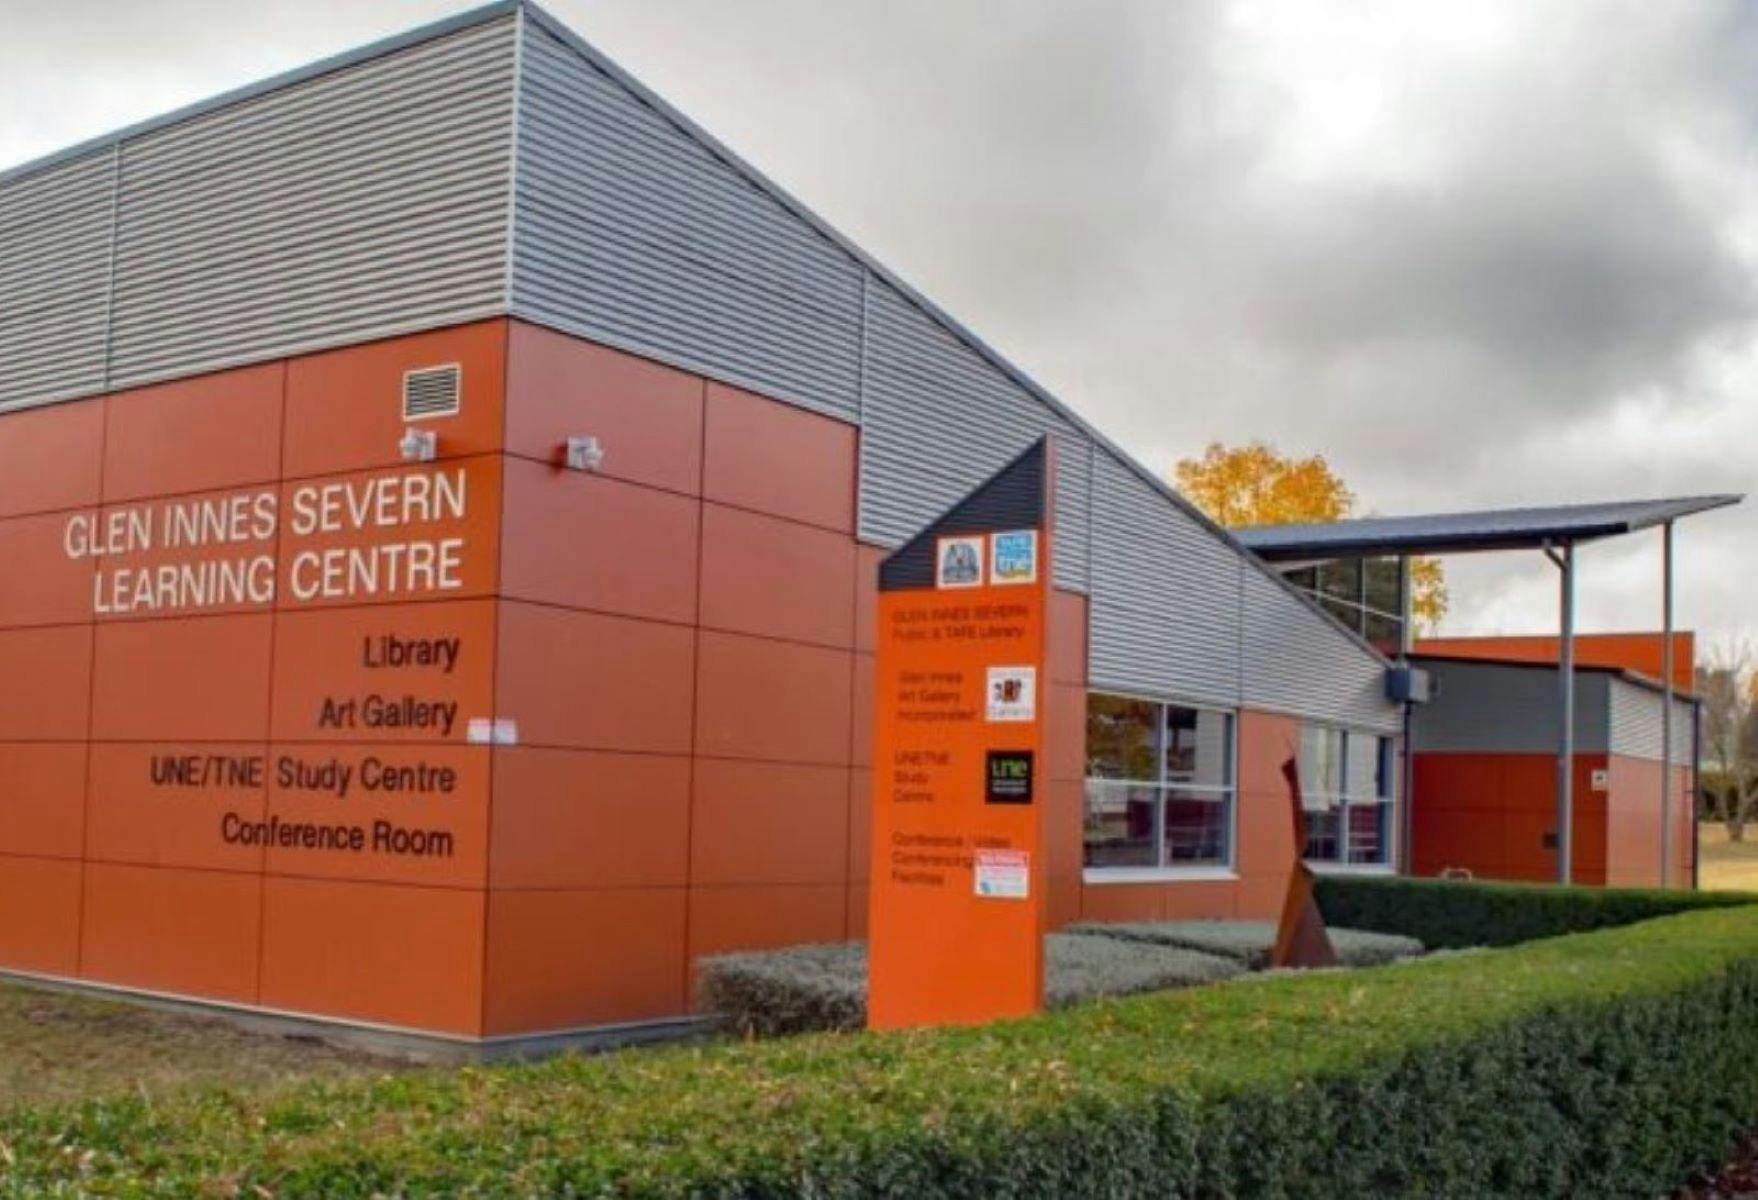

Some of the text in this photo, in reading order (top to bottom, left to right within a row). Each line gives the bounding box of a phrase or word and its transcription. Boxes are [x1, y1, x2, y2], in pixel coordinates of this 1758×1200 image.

[64, 468, 467, 559] GLEN INNES SEVERN
[93, 537, 464, 614] LEARNING CENTRE
[363, 635, 459, 673] Library
[319, 696, 458, 735] Art Gallery
[151, 756, 457, 797] UNE/TNE Study Centre
[222, 812, 453, 857] Conference Room
